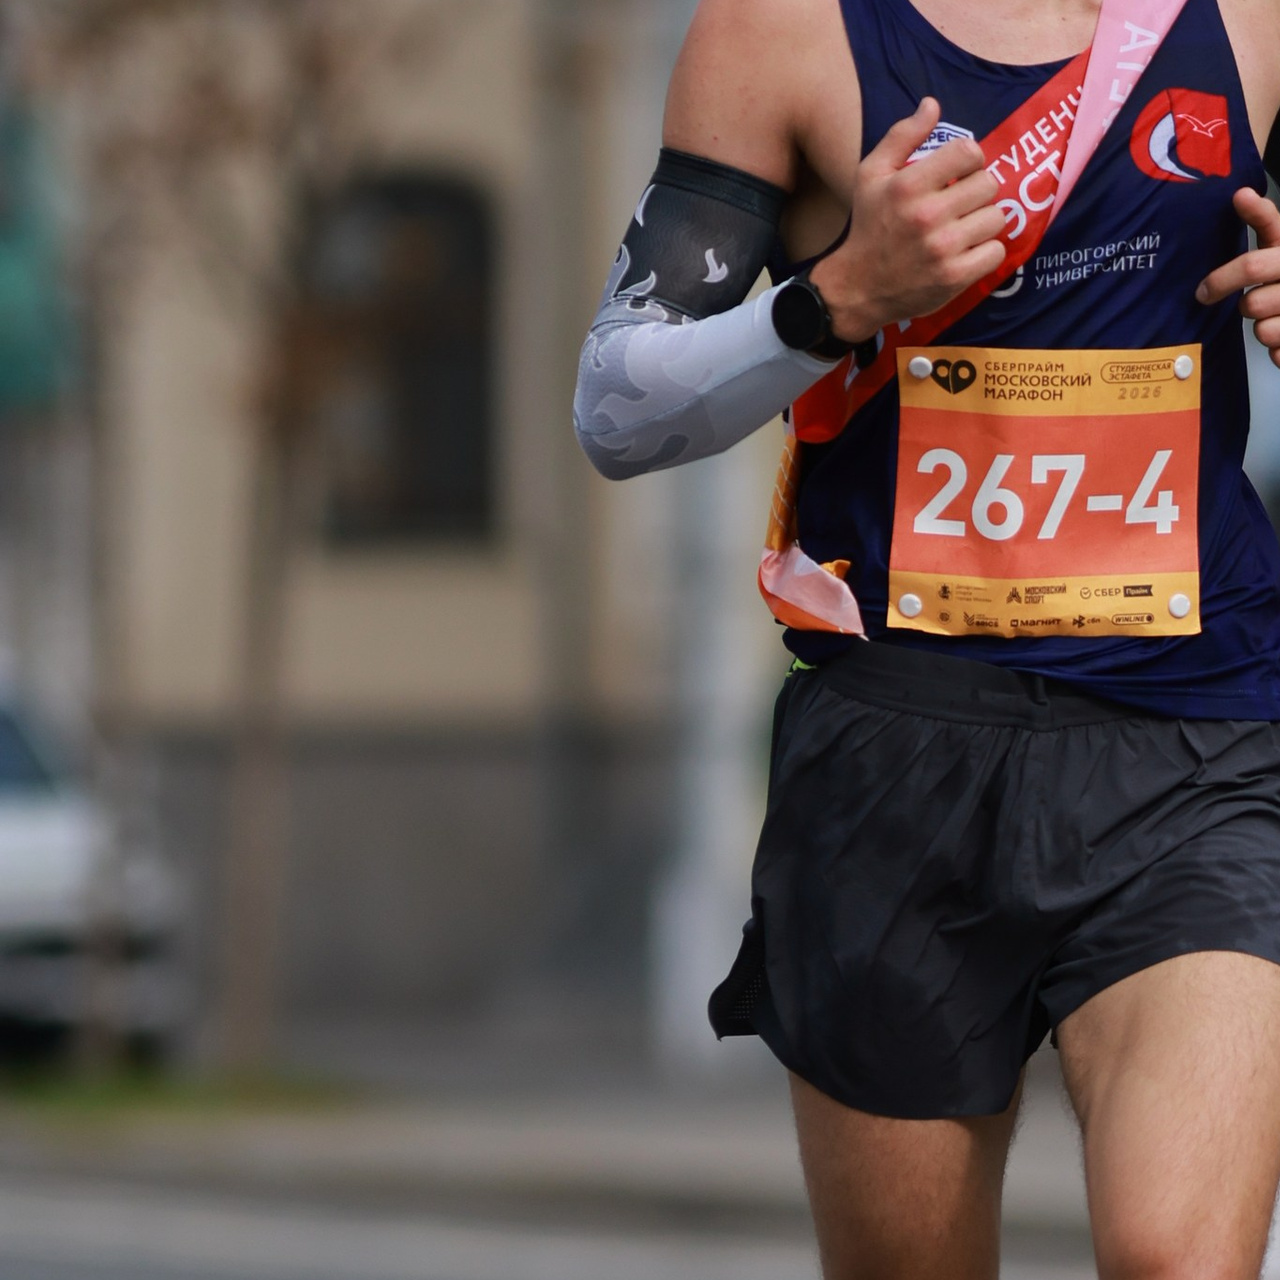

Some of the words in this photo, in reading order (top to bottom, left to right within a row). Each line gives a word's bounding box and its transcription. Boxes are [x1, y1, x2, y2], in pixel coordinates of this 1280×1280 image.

[984, 361, 1064, 372] СБЕРПРАЙМ
[1109, 362, 1172, 373] СТУДЕНЧЕСКАЯ
[984, 373, 1092, 387] МОСКОВСКИЙ
[1109, 372, 1152, 381] ЭСТАФЕТА
[984, 388, 1063, 401] МАРАФОН
[913, 448, 1180, 541] 267-4
[1024, 584, 1067, 595] МОСКОВСКИЙ
[1094, 587, 1121, 597] СБЕР
